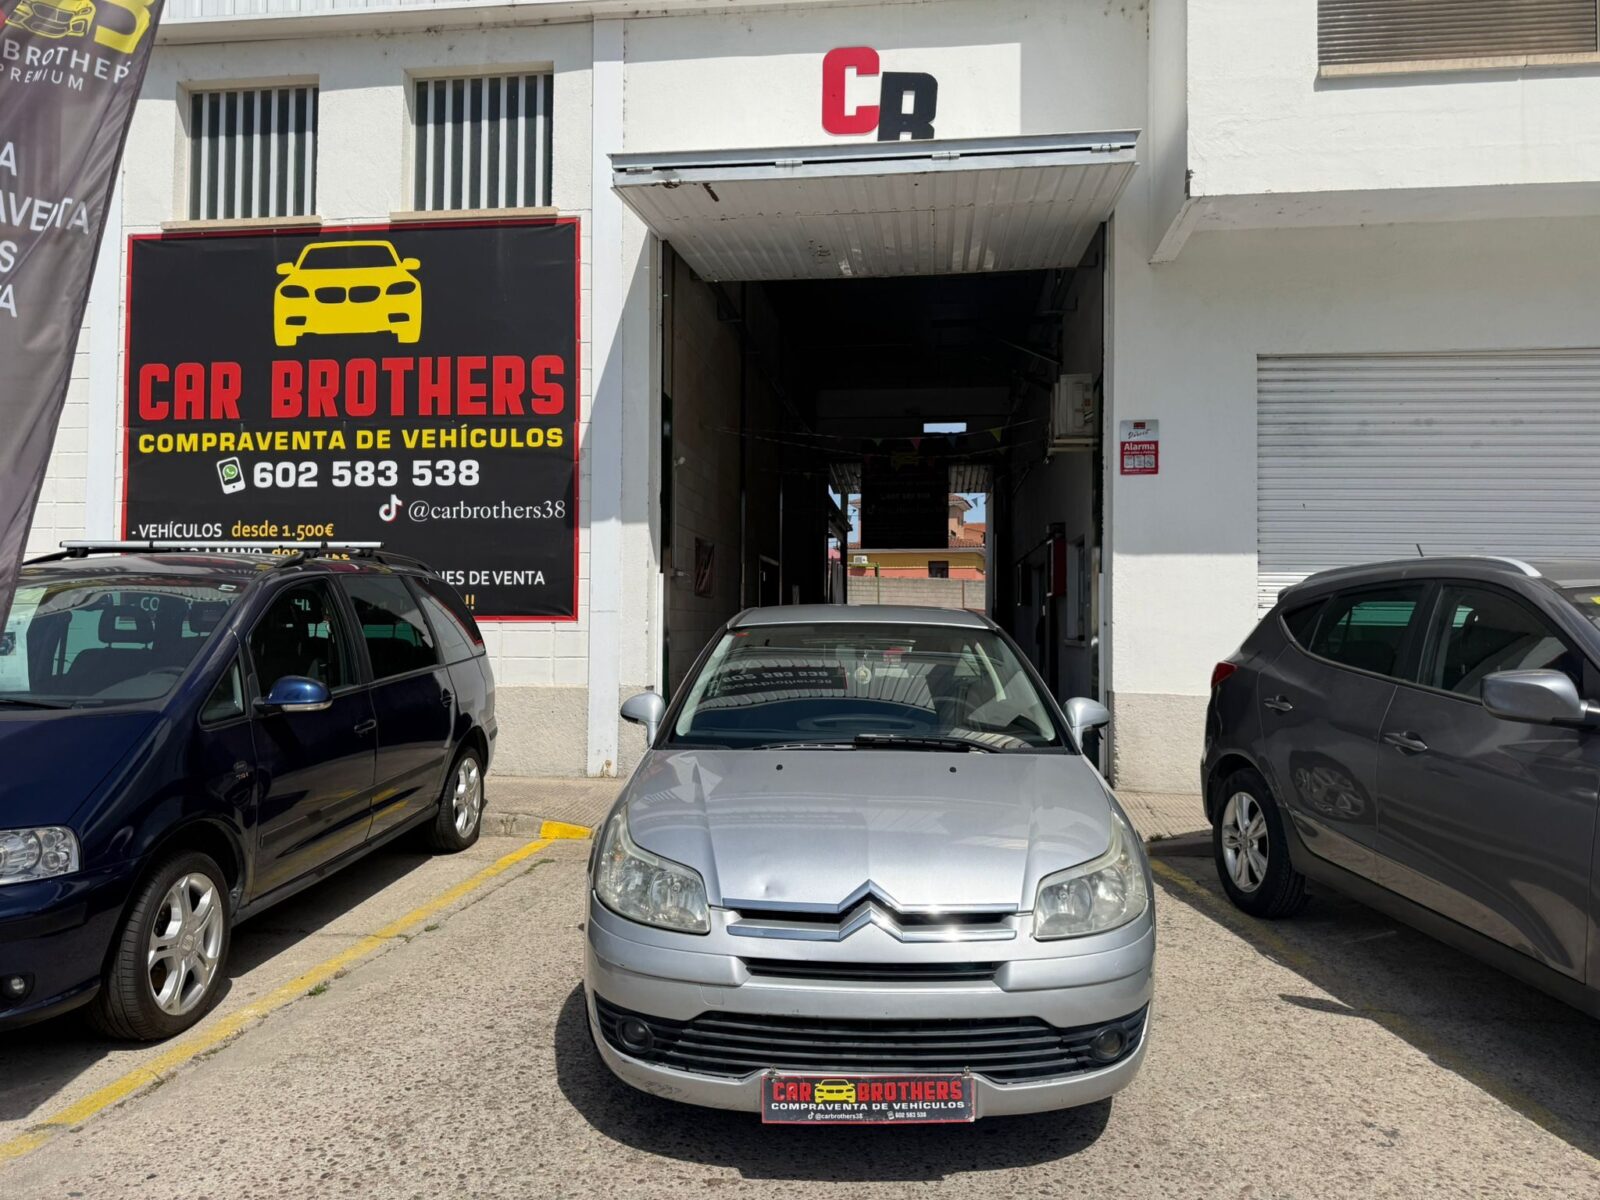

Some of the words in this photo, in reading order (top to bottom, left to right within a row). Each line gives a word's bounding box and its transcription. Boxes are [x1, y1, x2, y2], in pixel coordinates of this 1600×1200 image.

[139, 361, 241, 420] CAR
[271, 355, 564, 419] BROTHERS
[138, 430, 346, 453] COMPRAVENTA
[356, 429, 391, 450] DE
[402, 423, 564, 449] VEHÍCULOS
[253, 460, 318, 488] 602
[332, 460, 398, 487] 583
[412, 459, 480, 486] 538
[408, 499, 566, 522] @carbrothers38
[139, 521, 222, 538] VEHÍCULOS
[231, 520, 278, 537] desde
[282, 523, 334, 541] 1.500€
[469, 570, 490, 585] DE
[492, 570, 545, 585] VENTA
[772, 1081, 811, 1101] CAR
[857, 1080, 964, 1101] BROTHERS
[771, 1102, 868, 1111] COMPRAVENTA
[872, 1102, 889, 1110] DE
[892, 1101, 965, 1110] VEHÍCULOS
[815, 1112, 863, 1120] @carbrothers38
